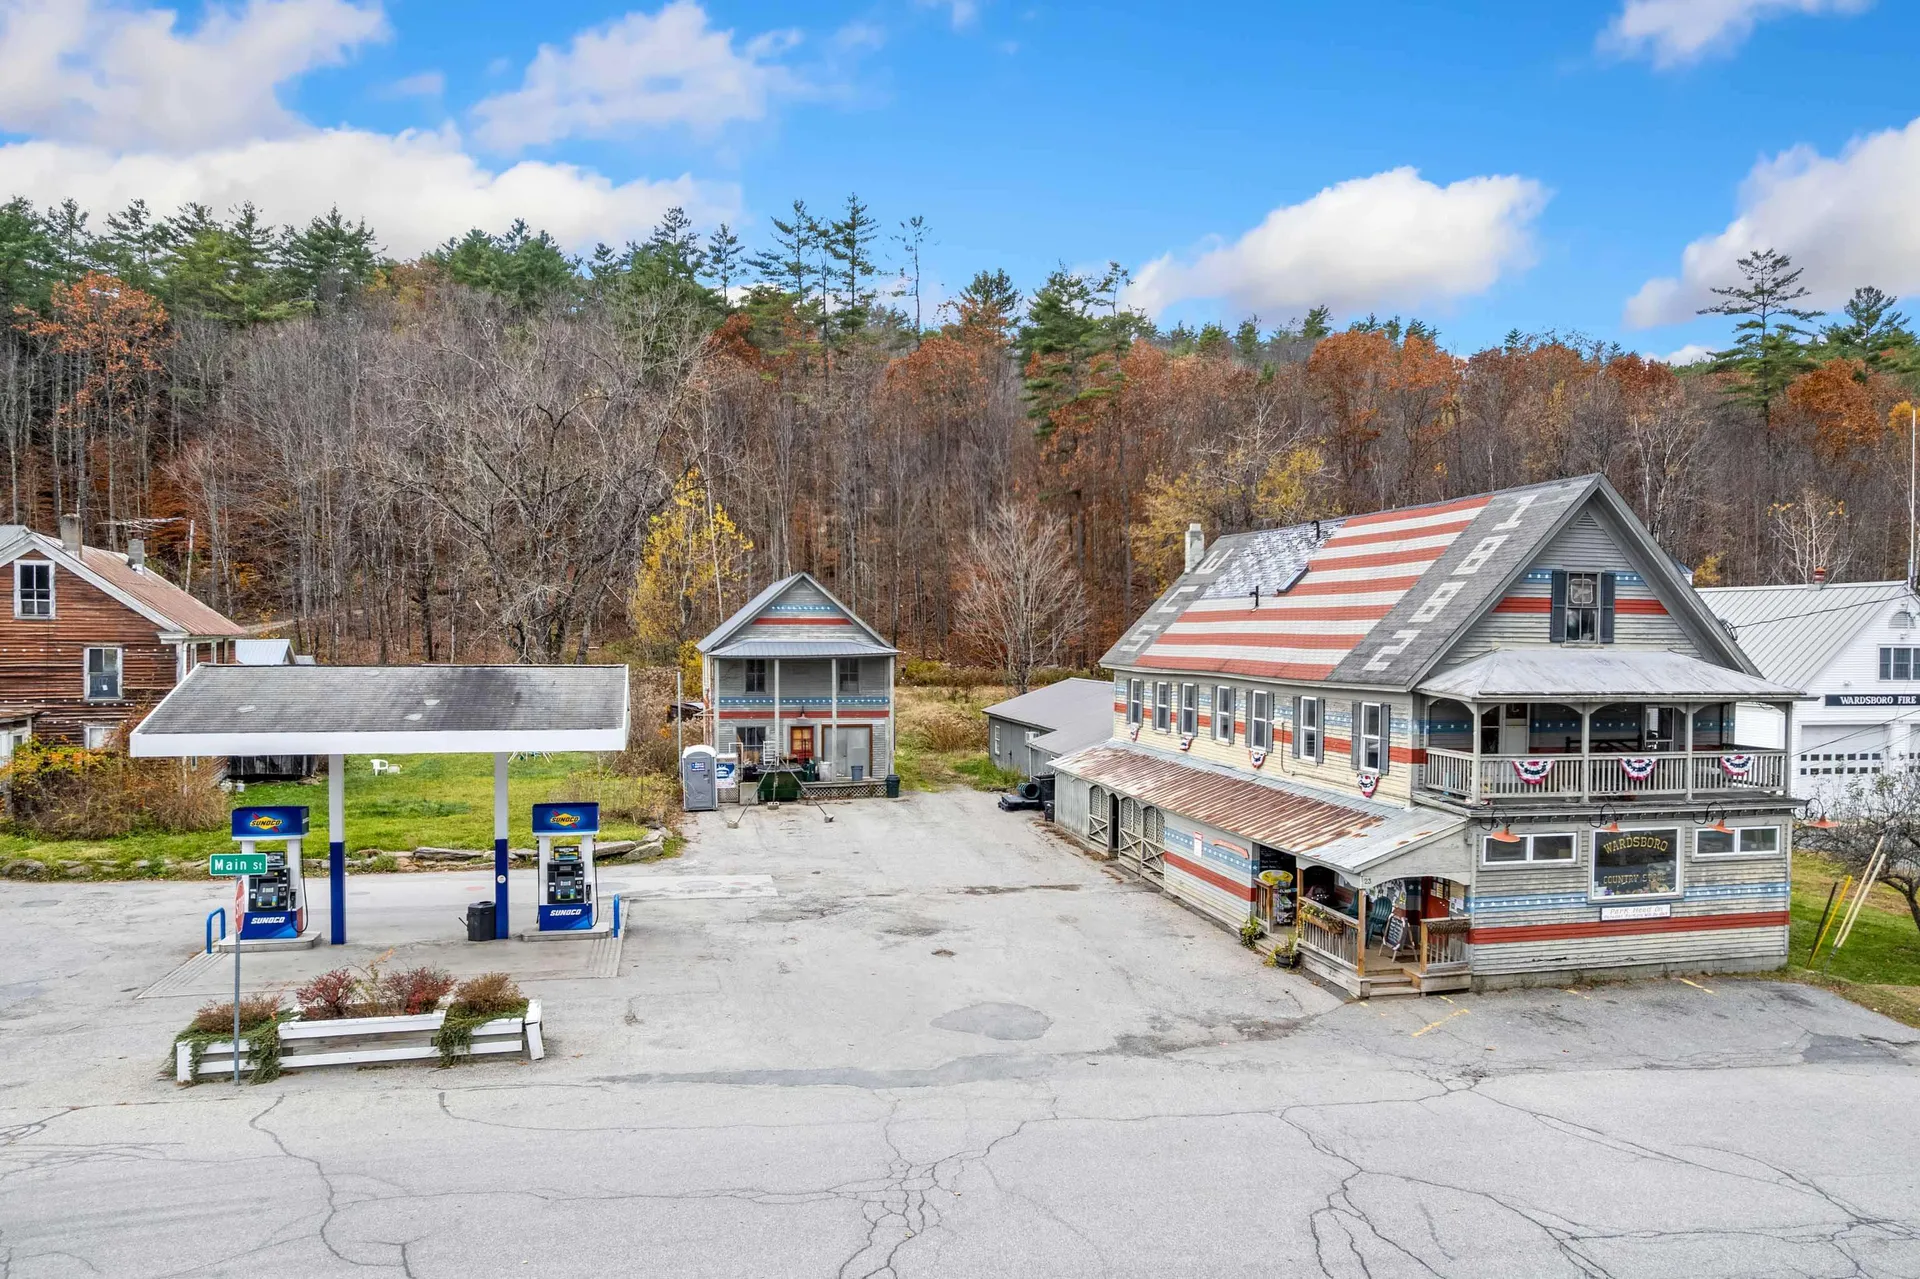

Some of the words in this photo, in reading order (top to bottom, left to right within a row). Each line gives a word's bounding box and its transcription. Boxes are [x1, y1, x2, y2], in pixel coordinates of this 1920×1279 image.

[1840, 696, 1894, 704] WARDSBORO
[1898, 696, 1916, 704] FIRE
[1603, 836, 1668, 854] WARDSBORO
[214, 858, 247, 871] Main
[252, 860, 263, 871] St
[1604, 874, 1640, 884] COUNTRY
[550, 908, 582, 916] SUNOCO
[251, 916, 286, 924] SUNOCO
